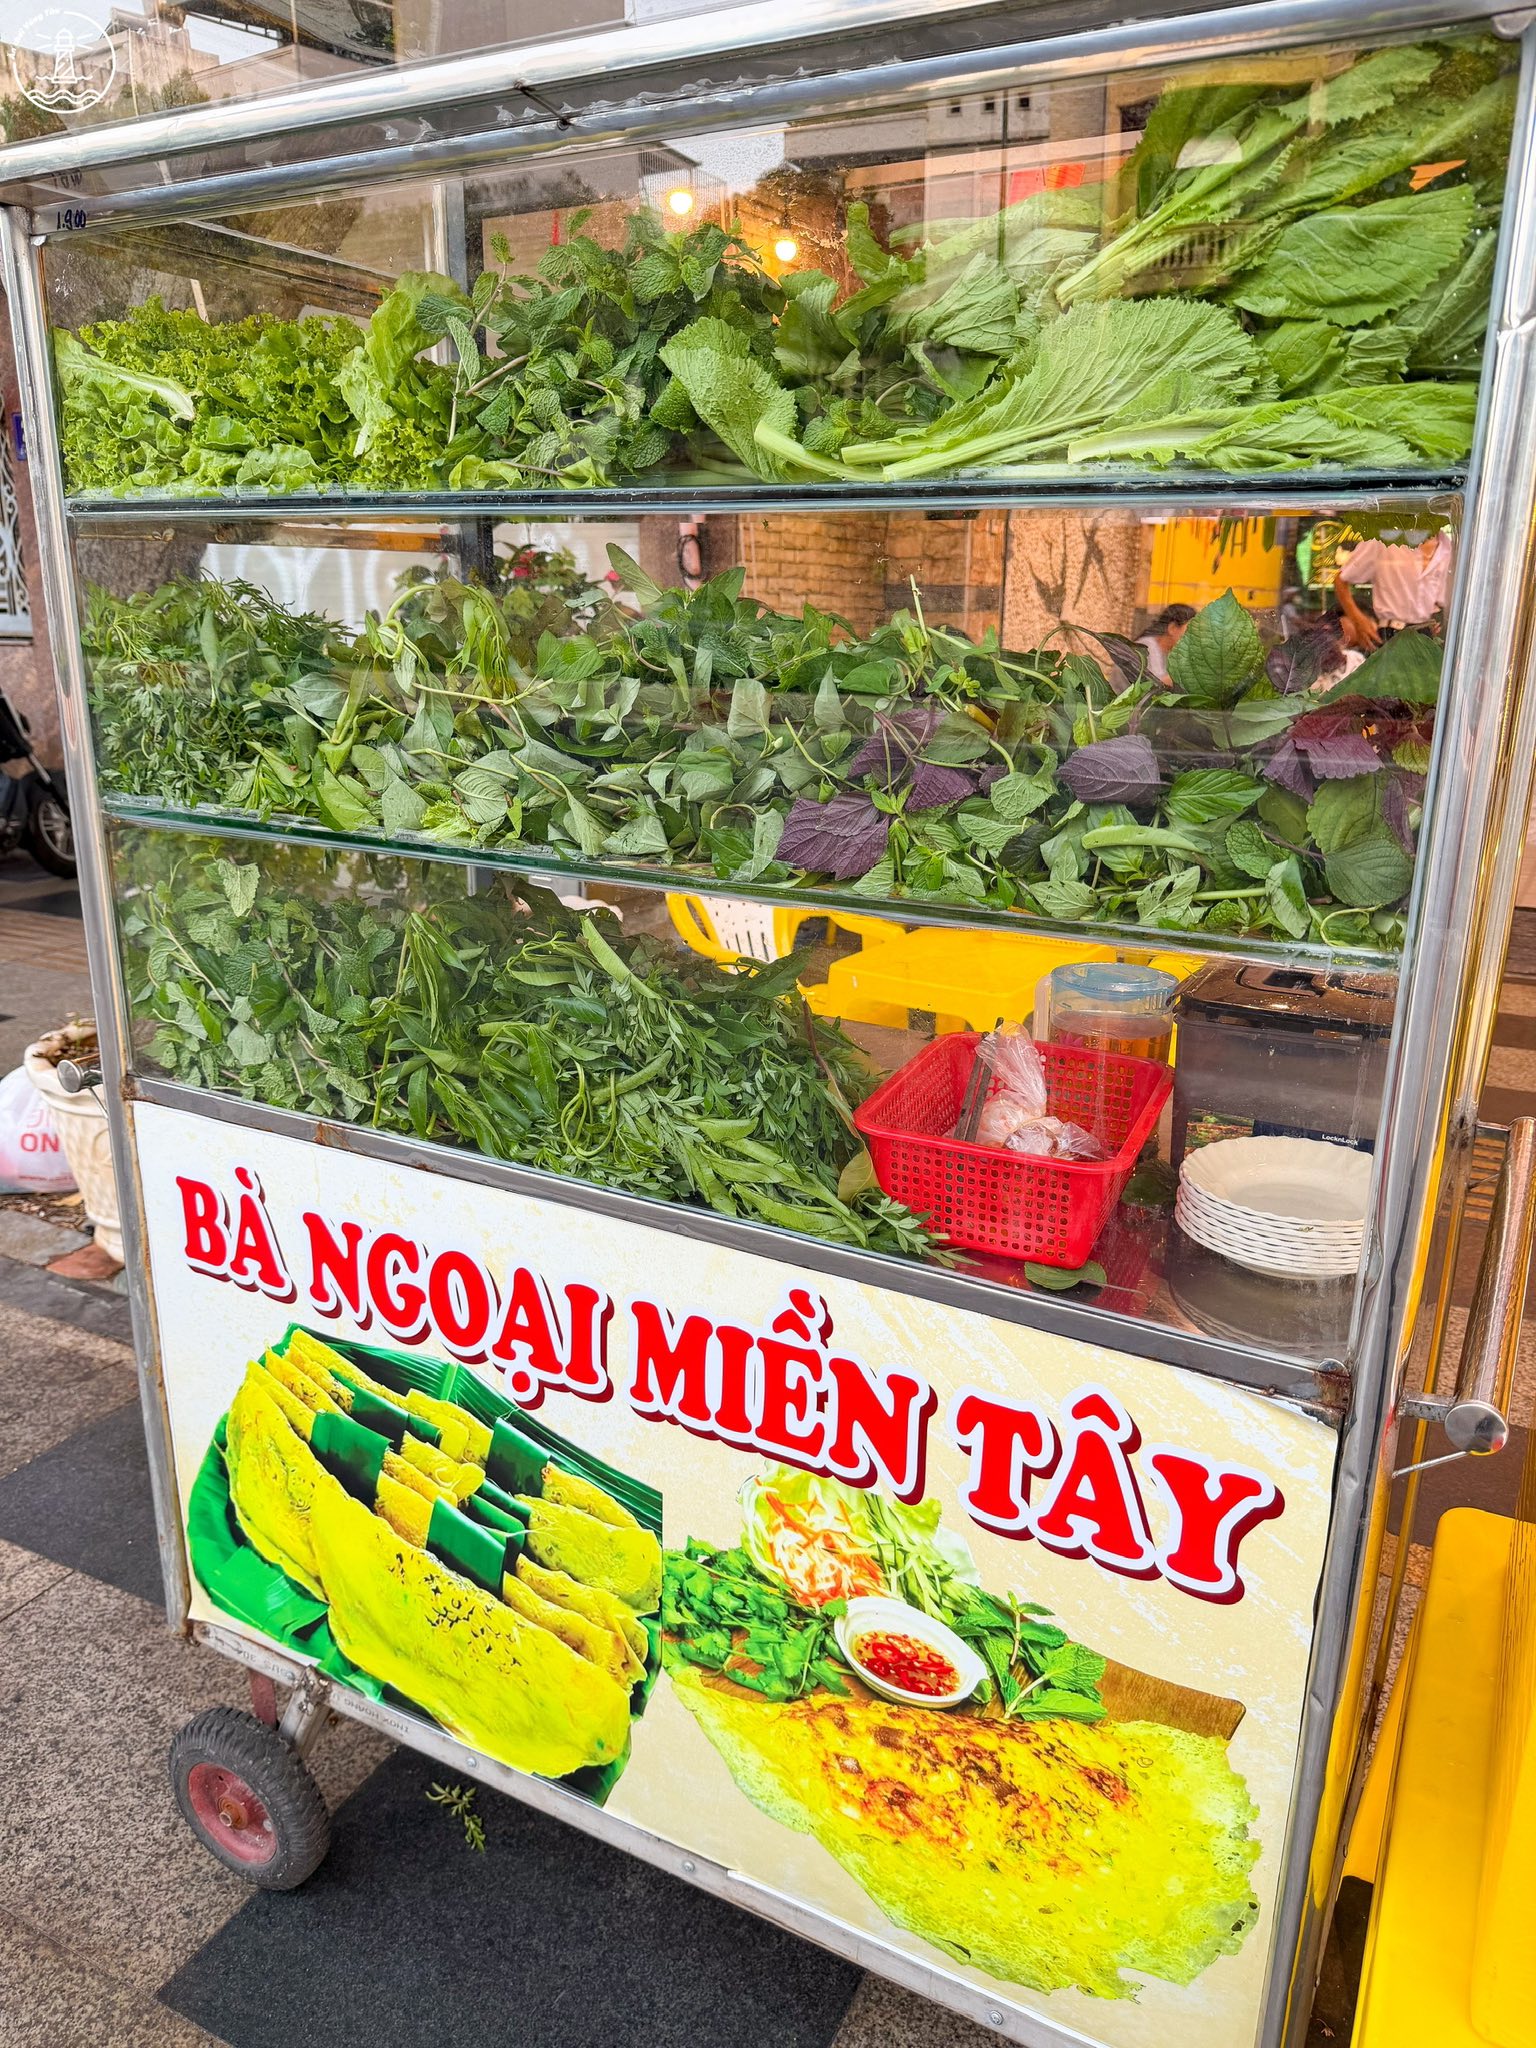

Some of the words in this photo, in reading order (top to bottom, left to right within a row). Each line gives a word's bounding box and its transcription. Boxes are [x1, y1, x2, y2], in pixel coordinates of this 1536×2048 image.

[57, 209, 87, 230] 1.900
[1321, 1133, 1359, 1146] LocknLock
[175, 1166, 294, 1299] BÀ
[301, 1211, 611, 1404] NGOẠI
[628, 1286, 933, 1501] MIỀN
[955, 1391, 1280, 1598] TÂY
